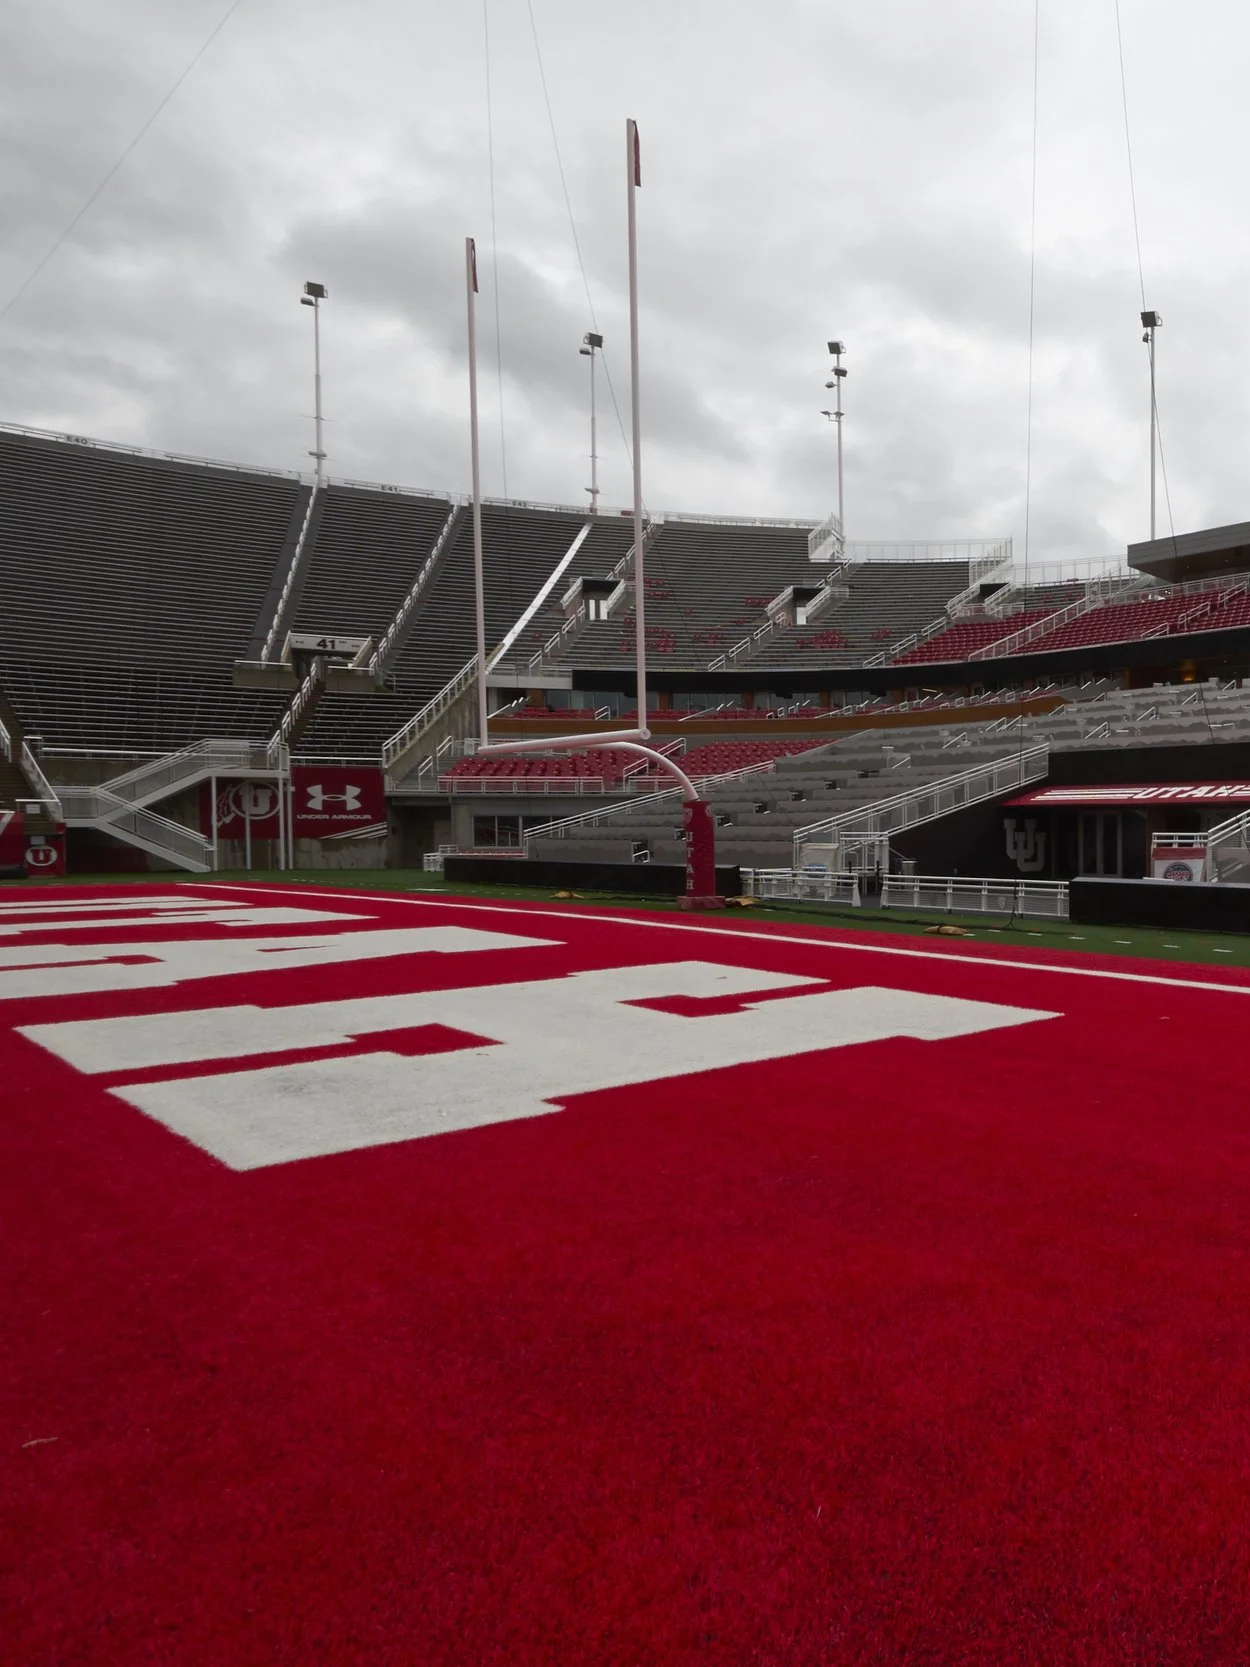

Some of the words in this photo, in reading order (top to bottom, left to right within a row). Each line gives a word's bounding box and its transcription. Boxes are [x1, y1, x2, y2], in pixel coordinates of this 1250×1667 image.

[316, 638, 336, 649] 41
[1133, 785, 1246, 799] UTAH
[686, 832, 695, 890] UTAH
